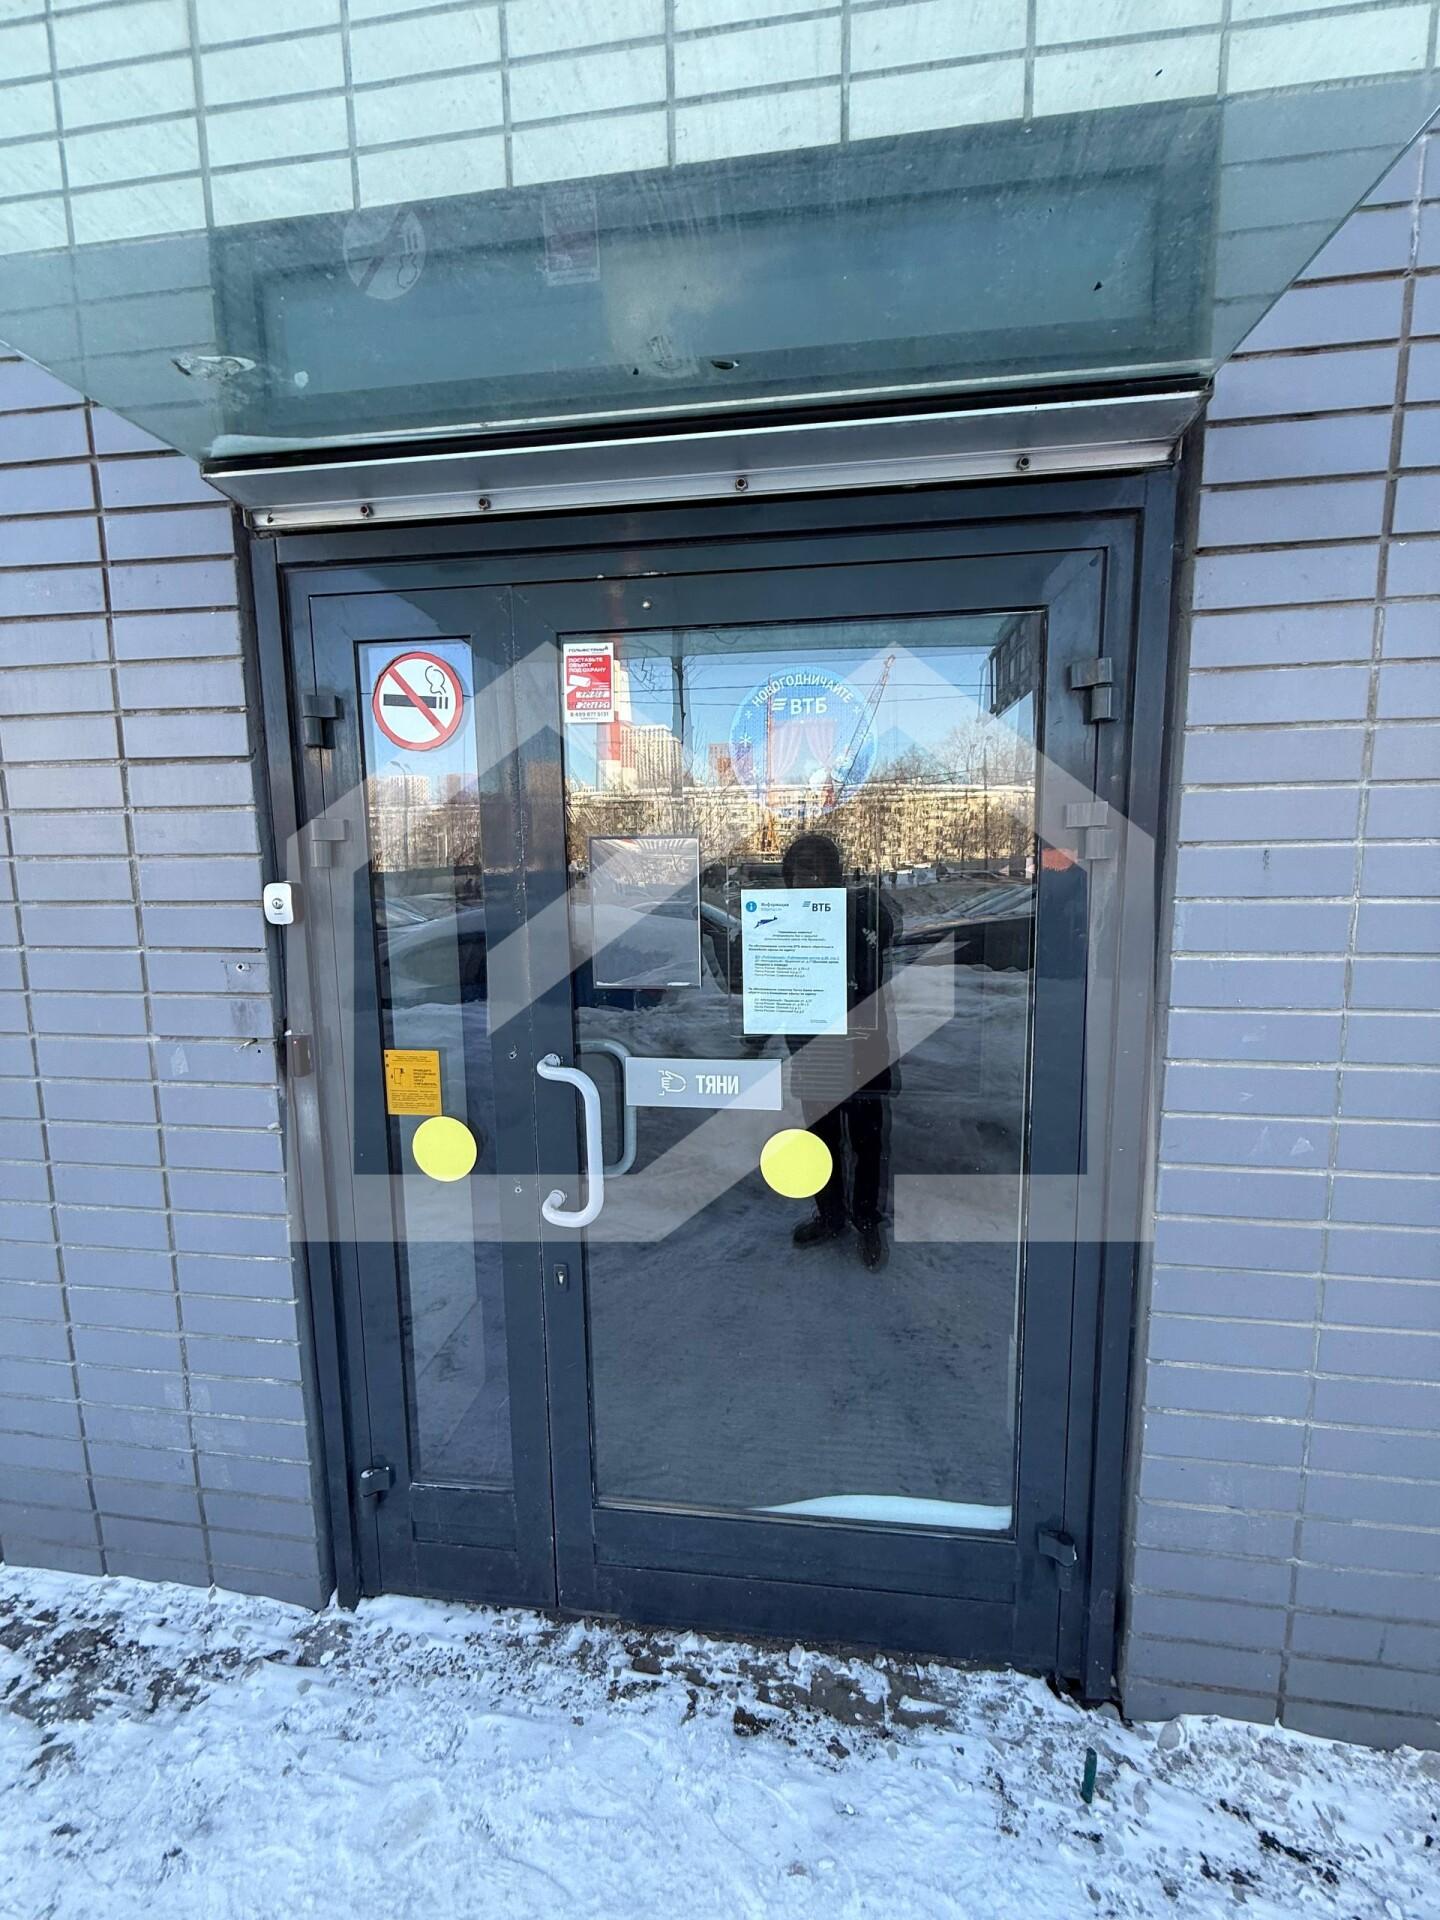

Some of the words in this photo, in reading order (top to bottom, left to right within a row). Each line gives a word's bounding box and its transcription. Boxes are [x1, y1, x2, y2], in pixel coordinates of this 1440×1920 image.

[790, 697, 828, 715] ВТБ
[812, 903, 831, 912] ВТБ
[695, 1074, 739, 1095] ТЯНИ
